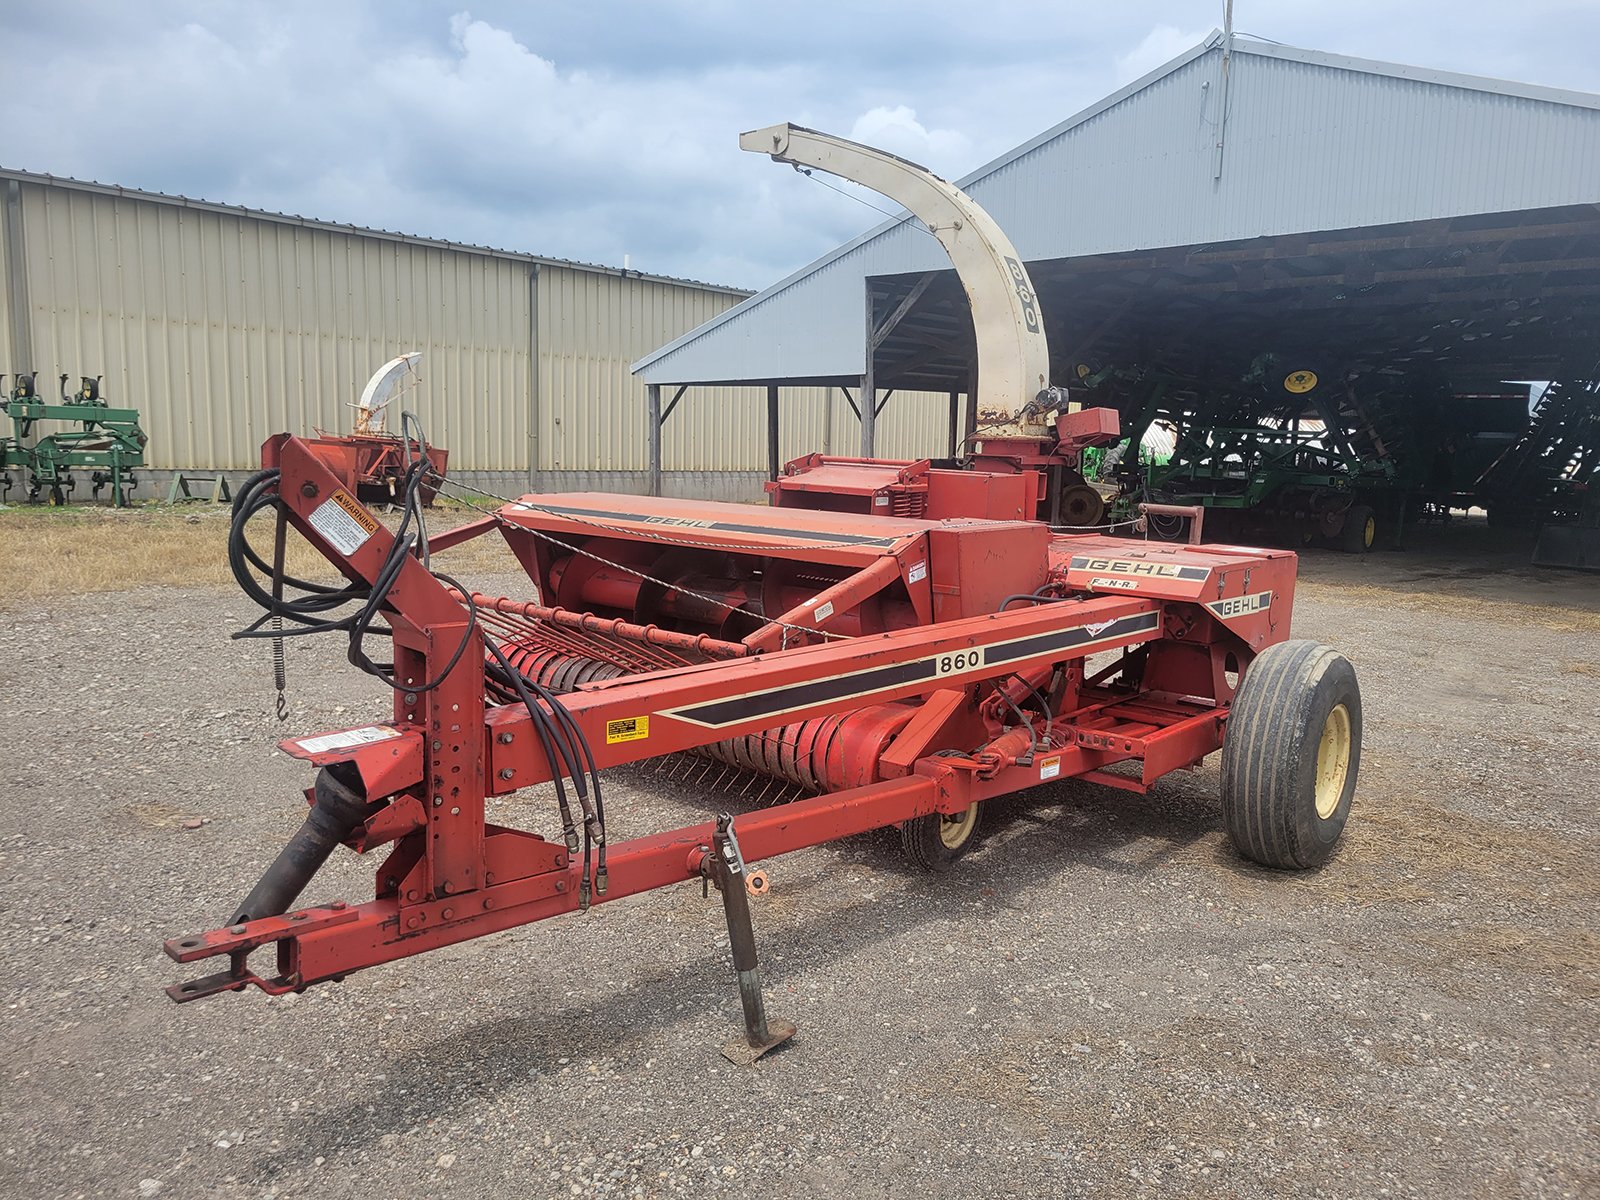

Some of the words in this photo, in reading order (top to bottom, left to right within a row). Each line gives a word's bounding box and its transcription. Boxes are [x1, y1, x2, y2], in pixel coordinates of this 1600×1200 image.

[1010, 263, 1036, 327] 860
[342, 498, 375, 532] WARNING
[646, 516, 707, 528] GEHL
[1089, 560, 1174, 577] GEHL
[1224, 597, 1258, 616] GEHL
[941, 651, 979, 673] 860
